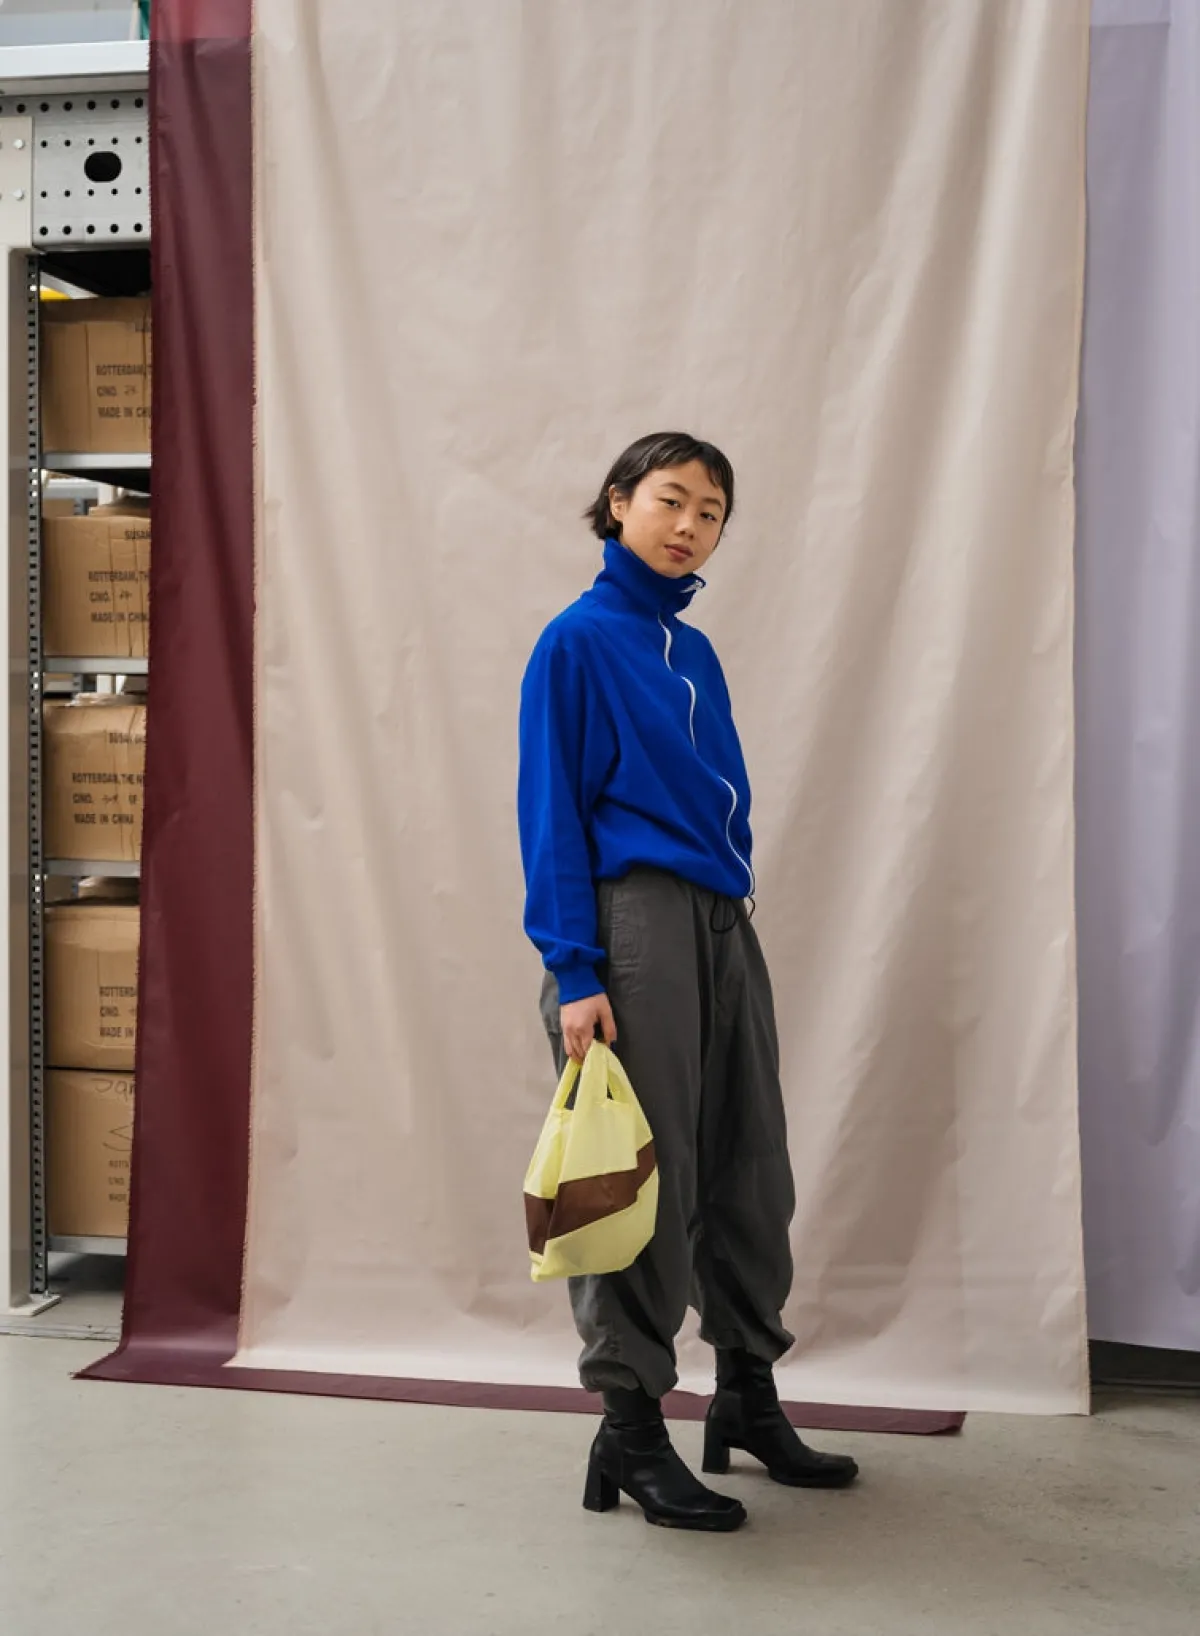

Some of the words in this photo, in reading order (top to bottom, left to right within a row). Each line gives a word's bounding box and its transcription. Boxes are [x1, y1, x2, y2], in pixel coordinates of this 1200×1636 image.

[74, 813, 97, 824] MADE
[100, 813, 109, 824] IN
[112, 813, 134, 824] CHINA
